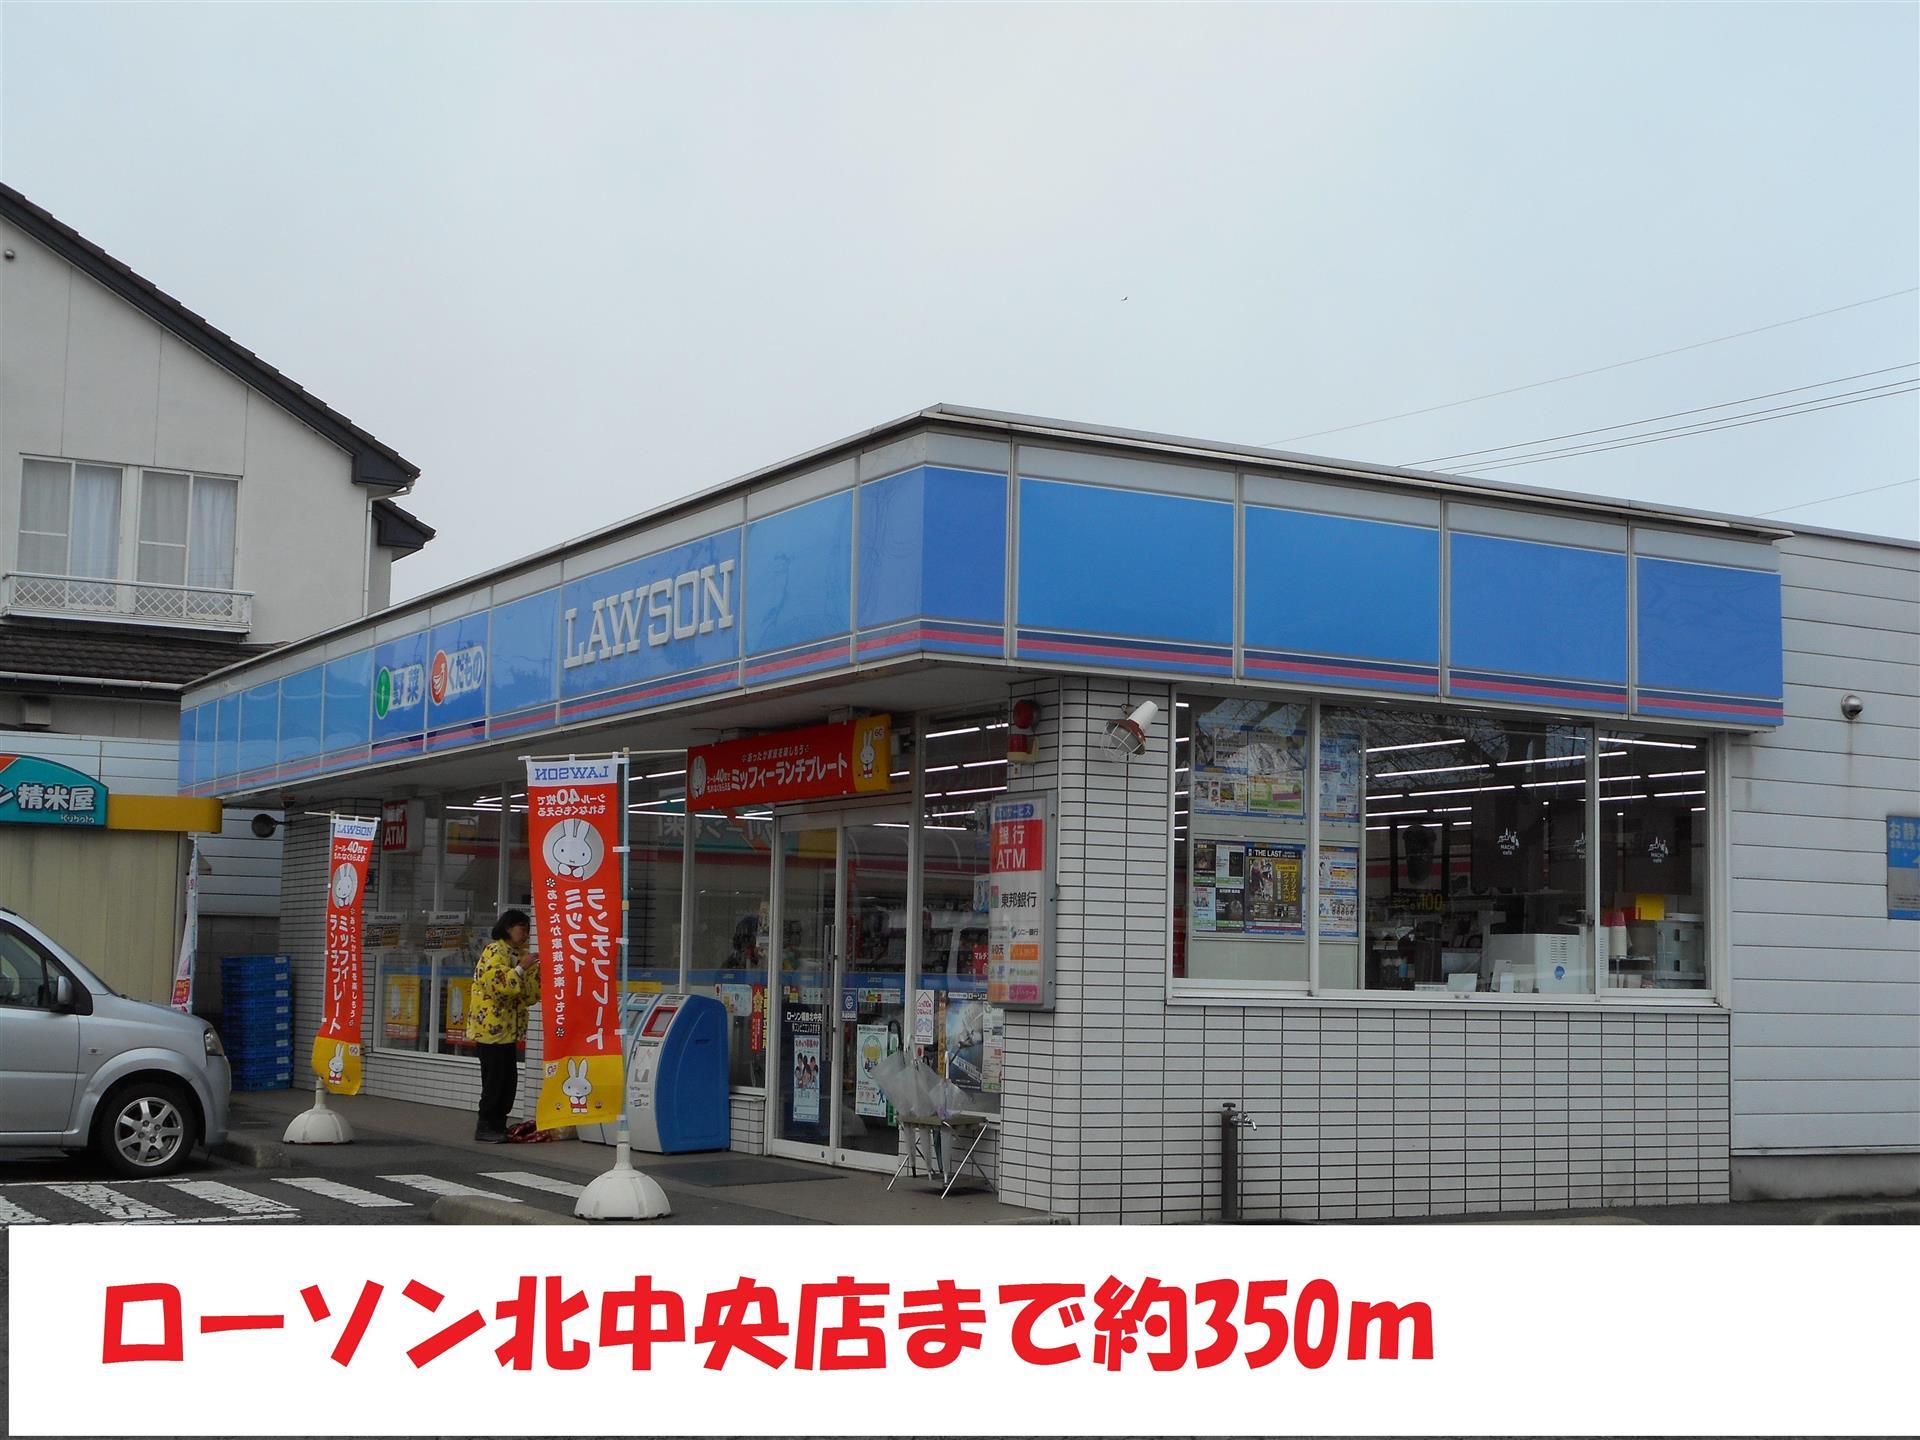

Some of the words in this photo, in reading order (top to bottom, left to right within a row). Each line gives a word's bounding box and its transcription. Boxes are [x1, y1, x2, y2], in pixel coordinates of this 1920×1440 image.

[563, 558, 736, 670] LAWSON
[448, 650, 483, 690] くだもの
[393, 666, 421, 706] 野菜
[731, 752, 848, 791] ミッフィーランチプレート
[336, 824, 375, 837] LAWSON
[384, 826, 405, 846] ATM
[999, 824, 1025, 846] 銀行
[996, 847, 1026, 870] ATM
[1000, 891, 1037, 909] 東邦銀行
[328, 914, 343, 1036] ランチプレート
